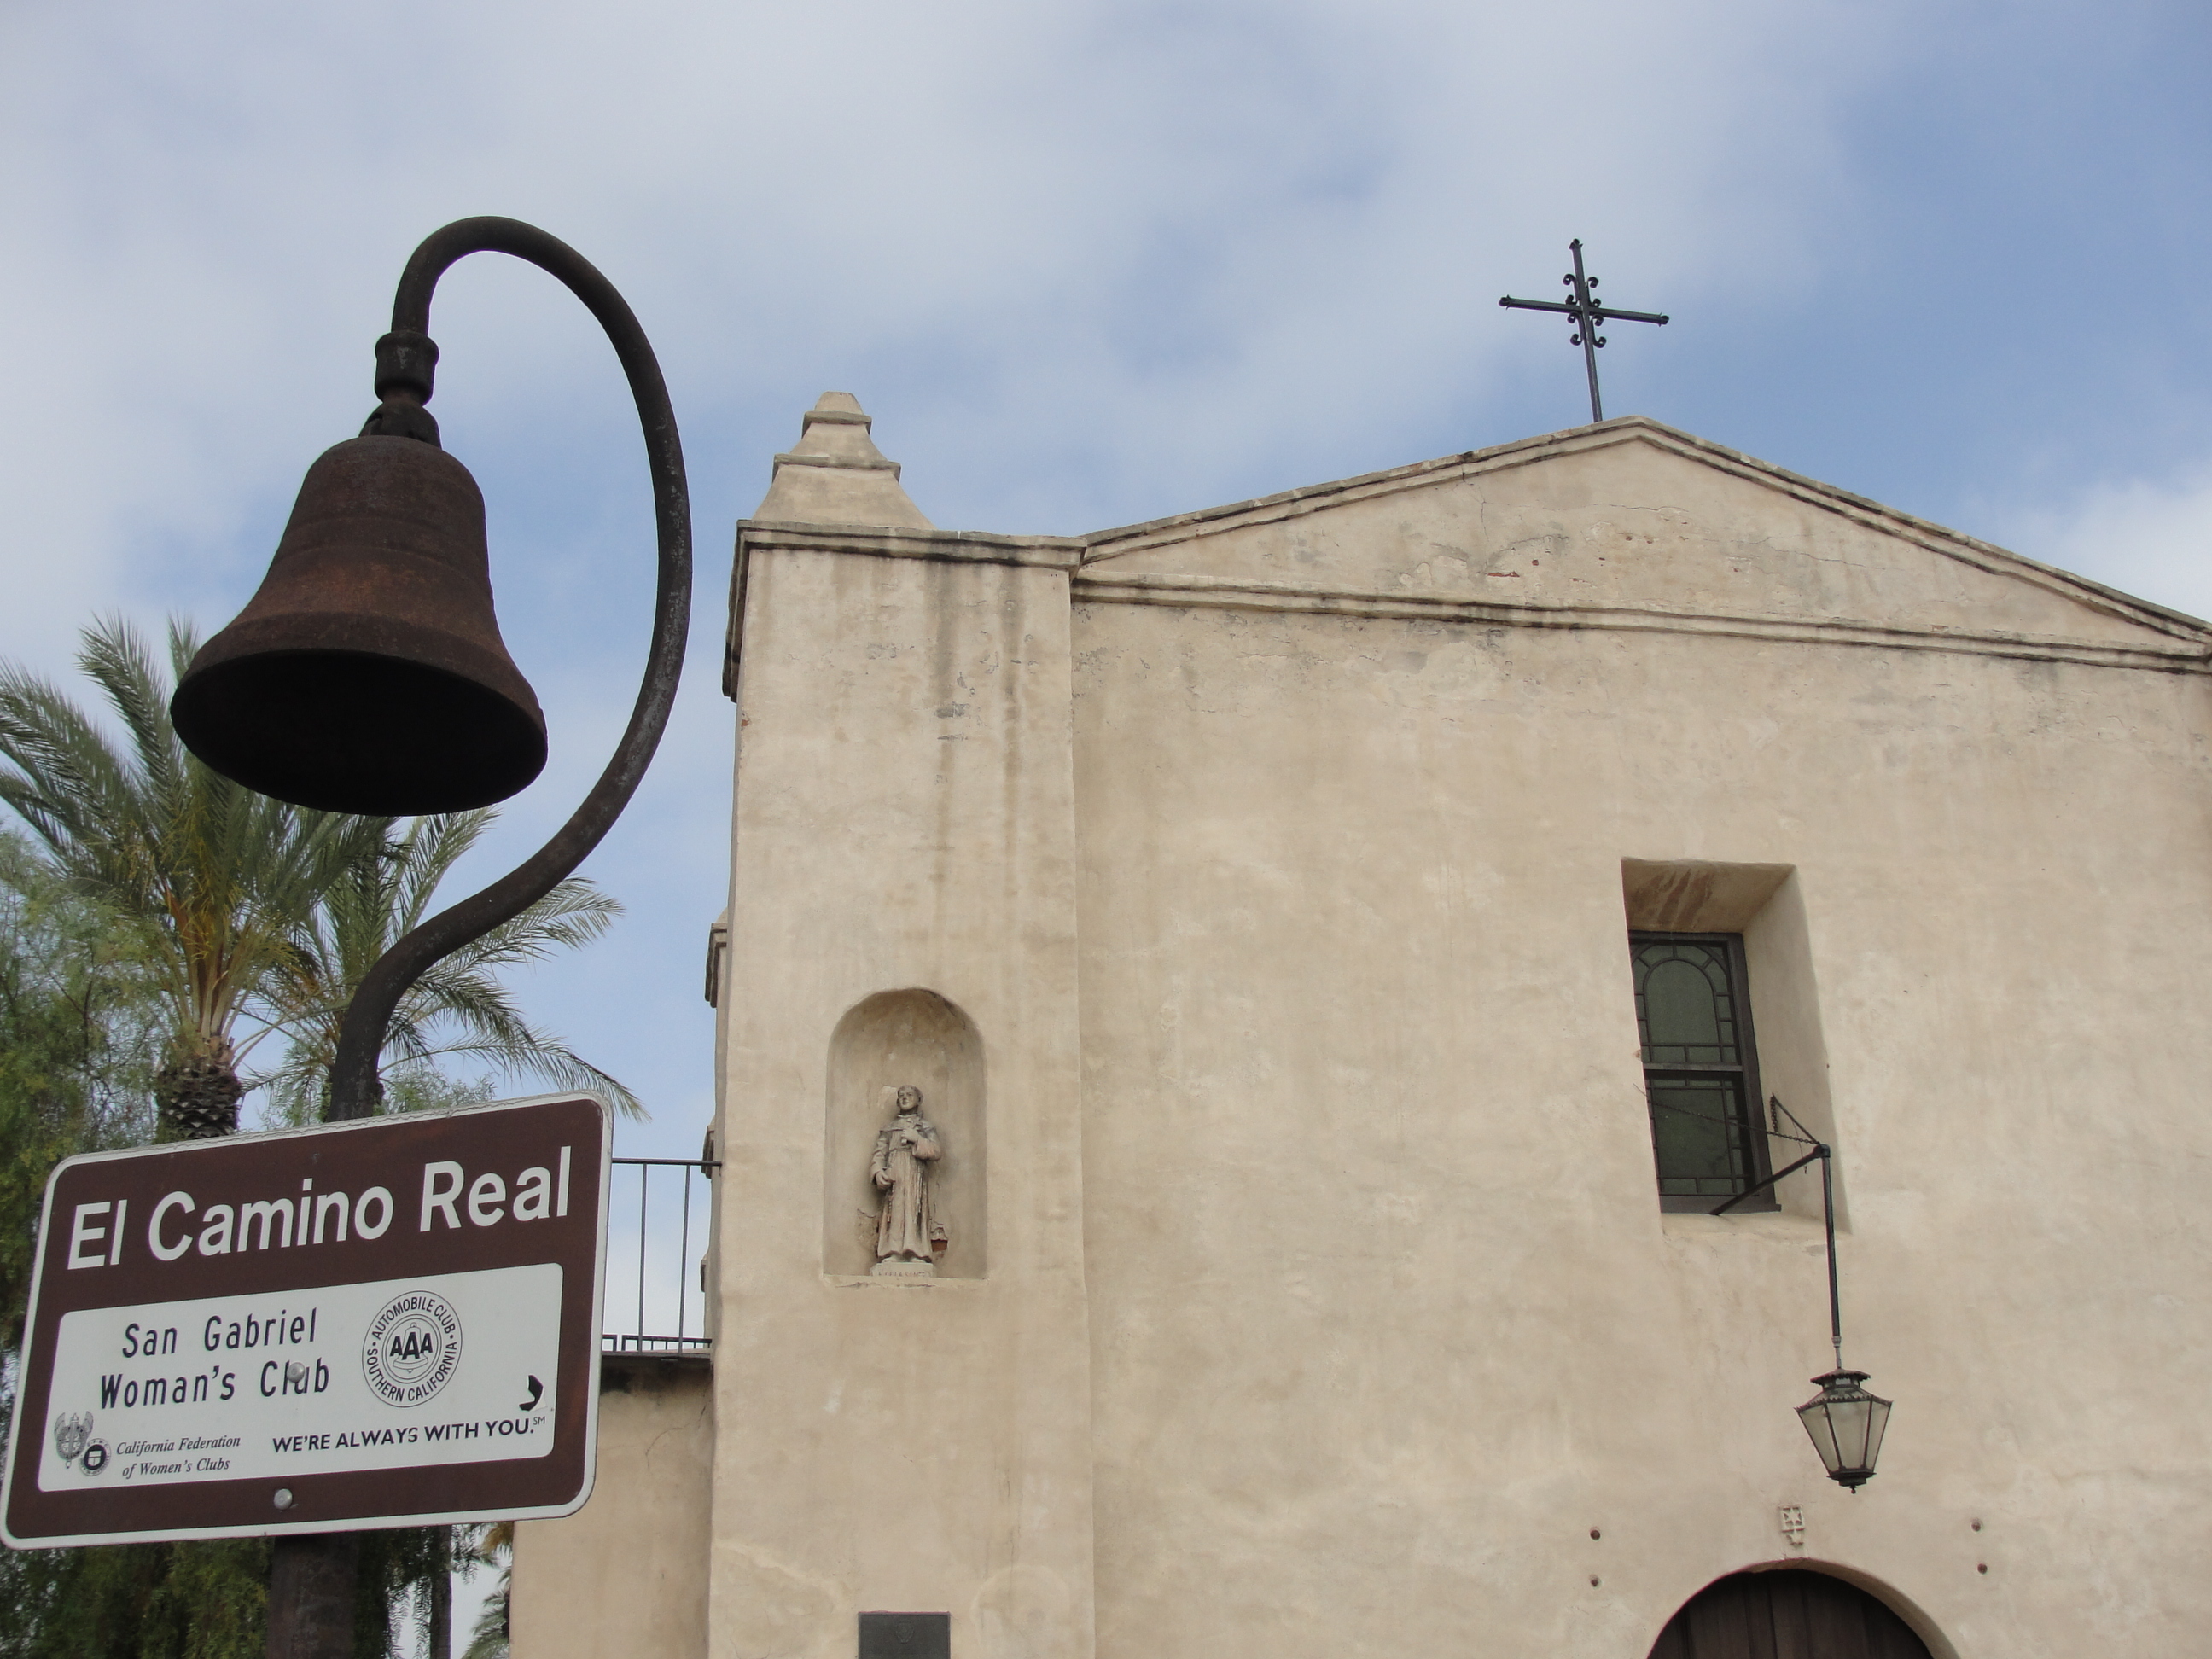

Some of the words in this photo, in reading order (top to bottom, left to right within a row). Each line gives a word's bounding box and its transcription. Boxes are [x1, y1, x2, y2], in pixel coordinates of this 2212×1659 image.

[68, 1200, 127, 1269] El
[149, 1179, 393, 1261] Camino
[420, 1146, 572, 1231] Real
[122, 1323, 178, 1359] San
[205, 1307, 317, 1352] Gabriel
[371, 1296, 436, 1341] AUTOMOBILE
[434, 1304, 456, 1334] CLUB
[389, 1331, 434, 1360] AAA
[101, 1366, 236, 1410] Woman's
[260, 1357, 329, 1397] Club
[366, 1348, 405, 1402] SOUTHERN
[407, 1341, 458, 1401] CALIFORNIA
[116, 1439, 175, 1456] California
[178, 1435, 241, 1451] Federation
[273, 1435, 331, 1453] WE'RE
[335, 1427, 418, 1449] ALWAYS
[423, 1422, 479, 1441] WITH
[122, 1463, 137, 1479] of
[140, 1460, 192, 1476] Women's
[196, 1458, 230, 1472] Clubs
